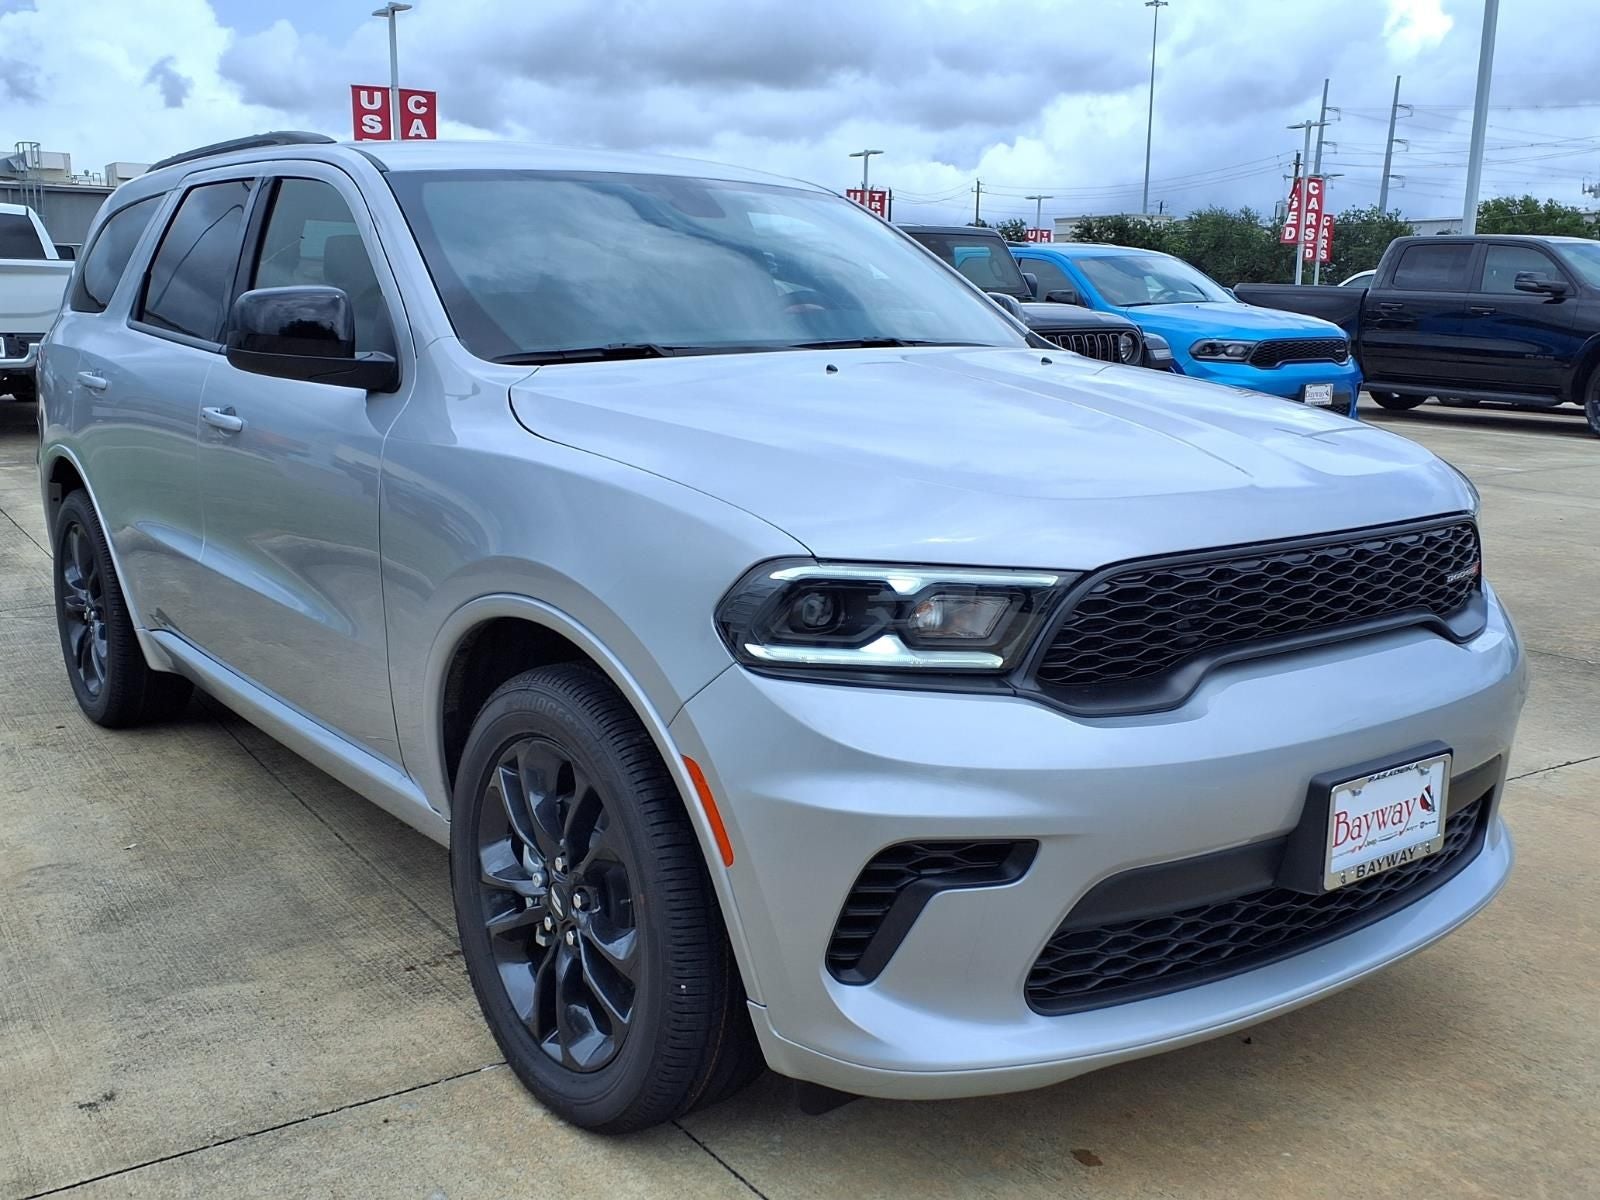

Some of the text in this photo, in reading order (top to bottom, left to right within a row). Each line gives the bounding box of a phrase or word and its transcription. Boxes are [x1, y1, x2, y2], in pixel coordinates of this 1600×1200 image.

[359, 90, 383, 140] US
[1304, 182, 1320, 241] CARS
[1320, 216, 1331, 259] CARS
[1332, 797, 1418, 853] Bayway
[1355, 845, 1418, 879] BAYWAY
